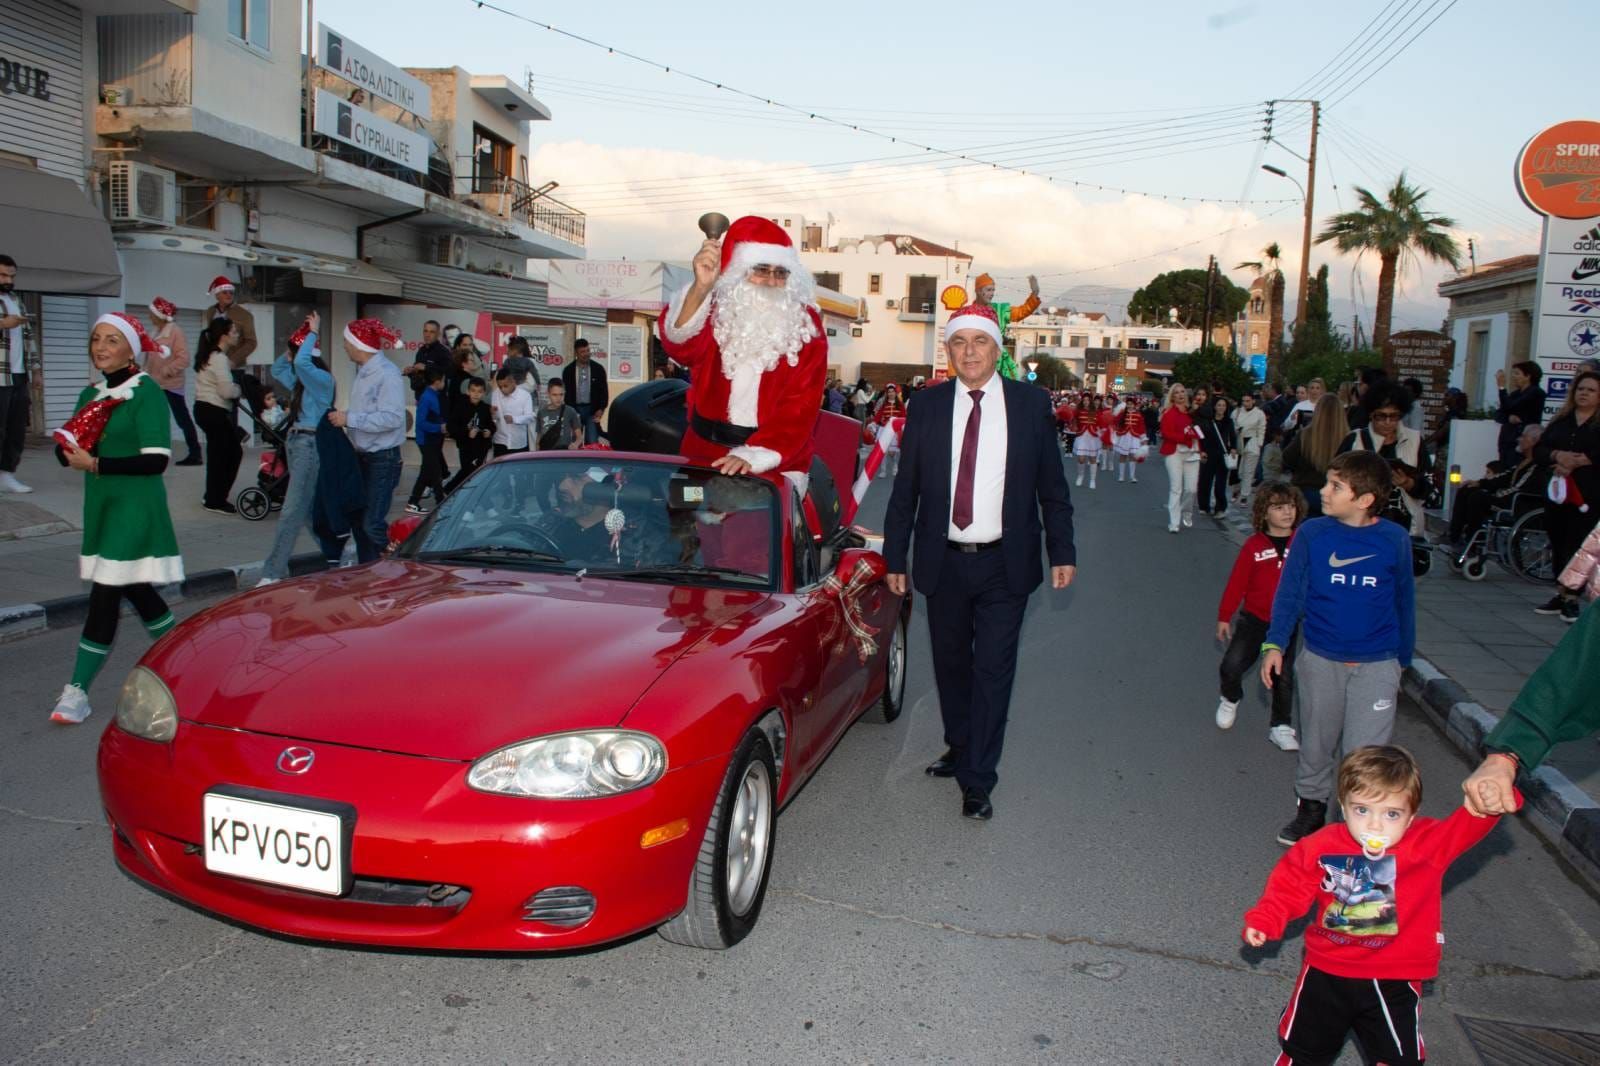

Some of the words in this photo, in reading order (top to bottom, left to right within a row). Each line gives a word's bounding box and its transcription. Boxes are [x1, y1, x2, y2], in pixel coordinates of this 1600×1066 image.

[344, 56, 414, 108] ΑΣΦΑΛΙΣΤΙΚΗ
[354, 123, 410, 162] CYPRIALIFE
[576, 262, 638, 277] GEORGE
[1330, 573, 1377, 587] AIR
